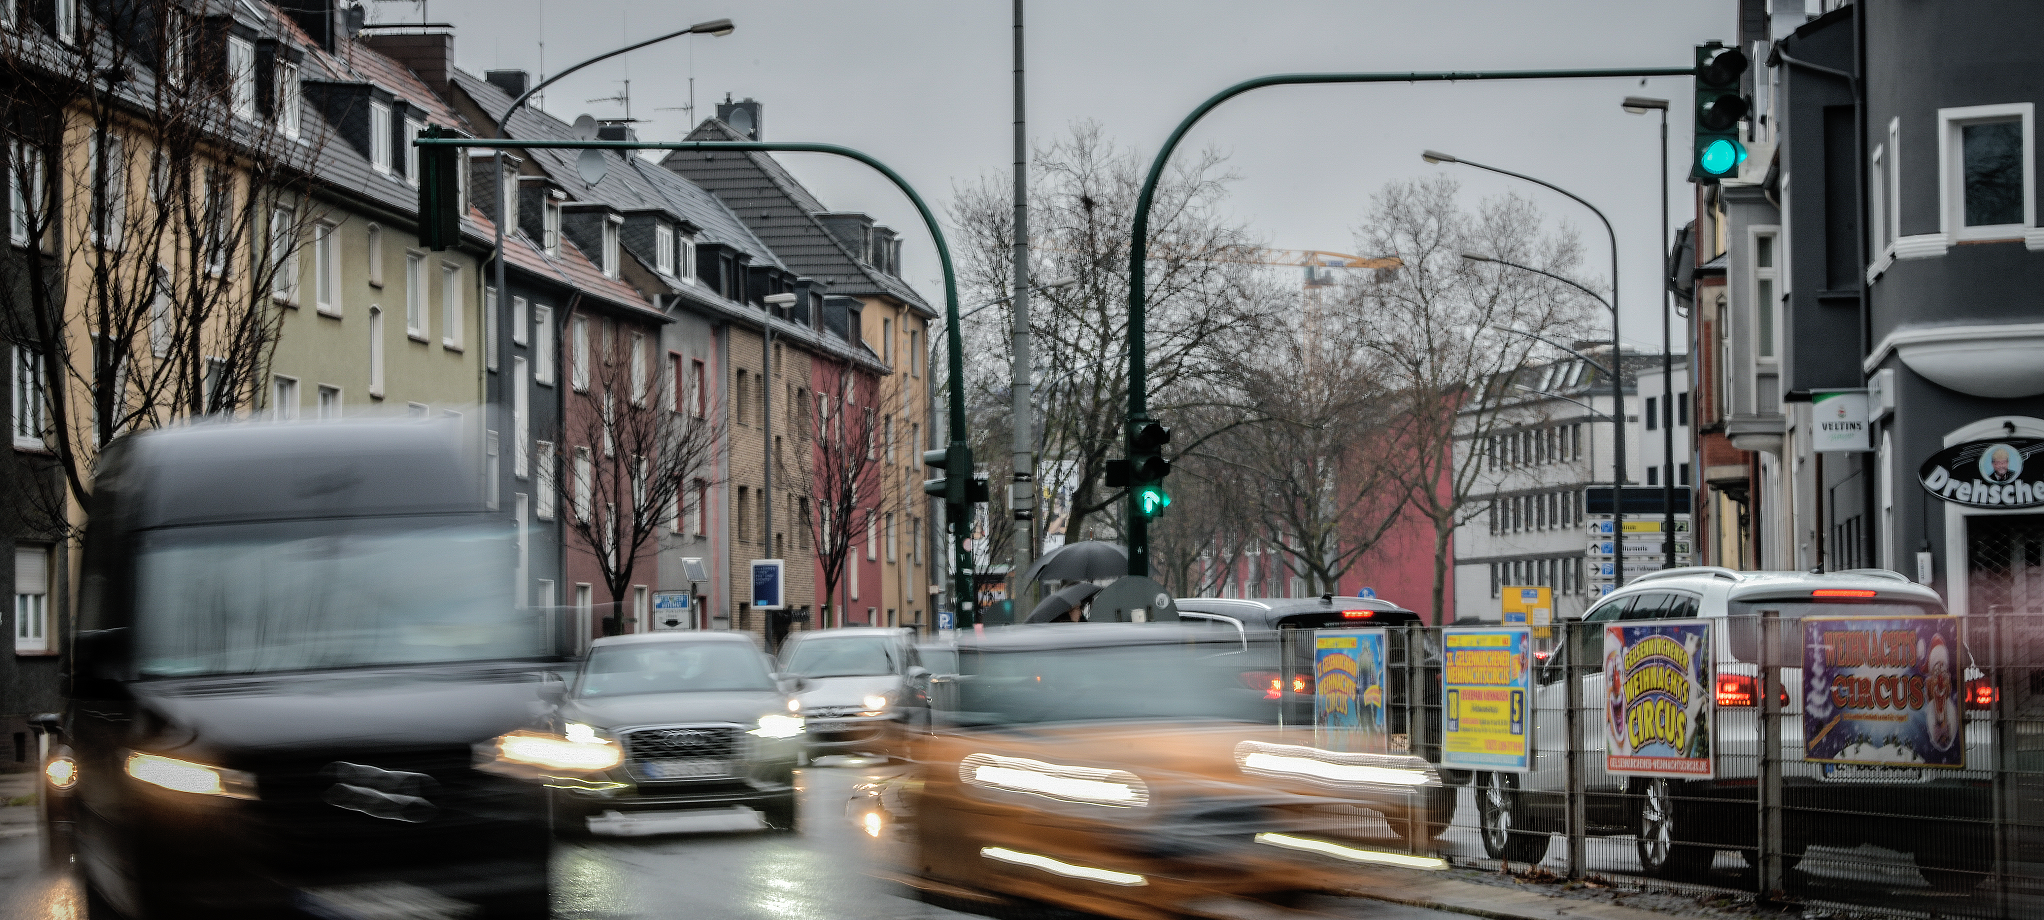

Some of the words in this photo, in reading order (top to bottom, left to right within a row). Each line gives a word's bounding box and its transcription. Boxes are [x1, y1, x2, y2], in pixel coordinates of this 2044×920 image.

[1821, 421, 1863, 431] VELTINS
[1924, 464, 2044, 506] Drehsche
[1455, 650, 1511, 667] GELSENKIRCHENER
[1624, 636, 1689, 674] GELSENKIRCHENER
[1823, 630, 1917, 668] WEIHNACHTS
[1317, 672, 1357, 702] WEIHNACHTS
[1446, 666, 1511, 685] WEIHNACHTSCIRCUS
[1624, 664, 1690, 708] WEIHNACHTS
[1326, 690, 1348, 717] CIRCUS
[1448, 691, 1458, 720] 18
[1513, 693, 1520, 722] 5
[1831, 674, 1925, 711] CIRCUS
[1628, 697, 1687, 754] CIRCUS
